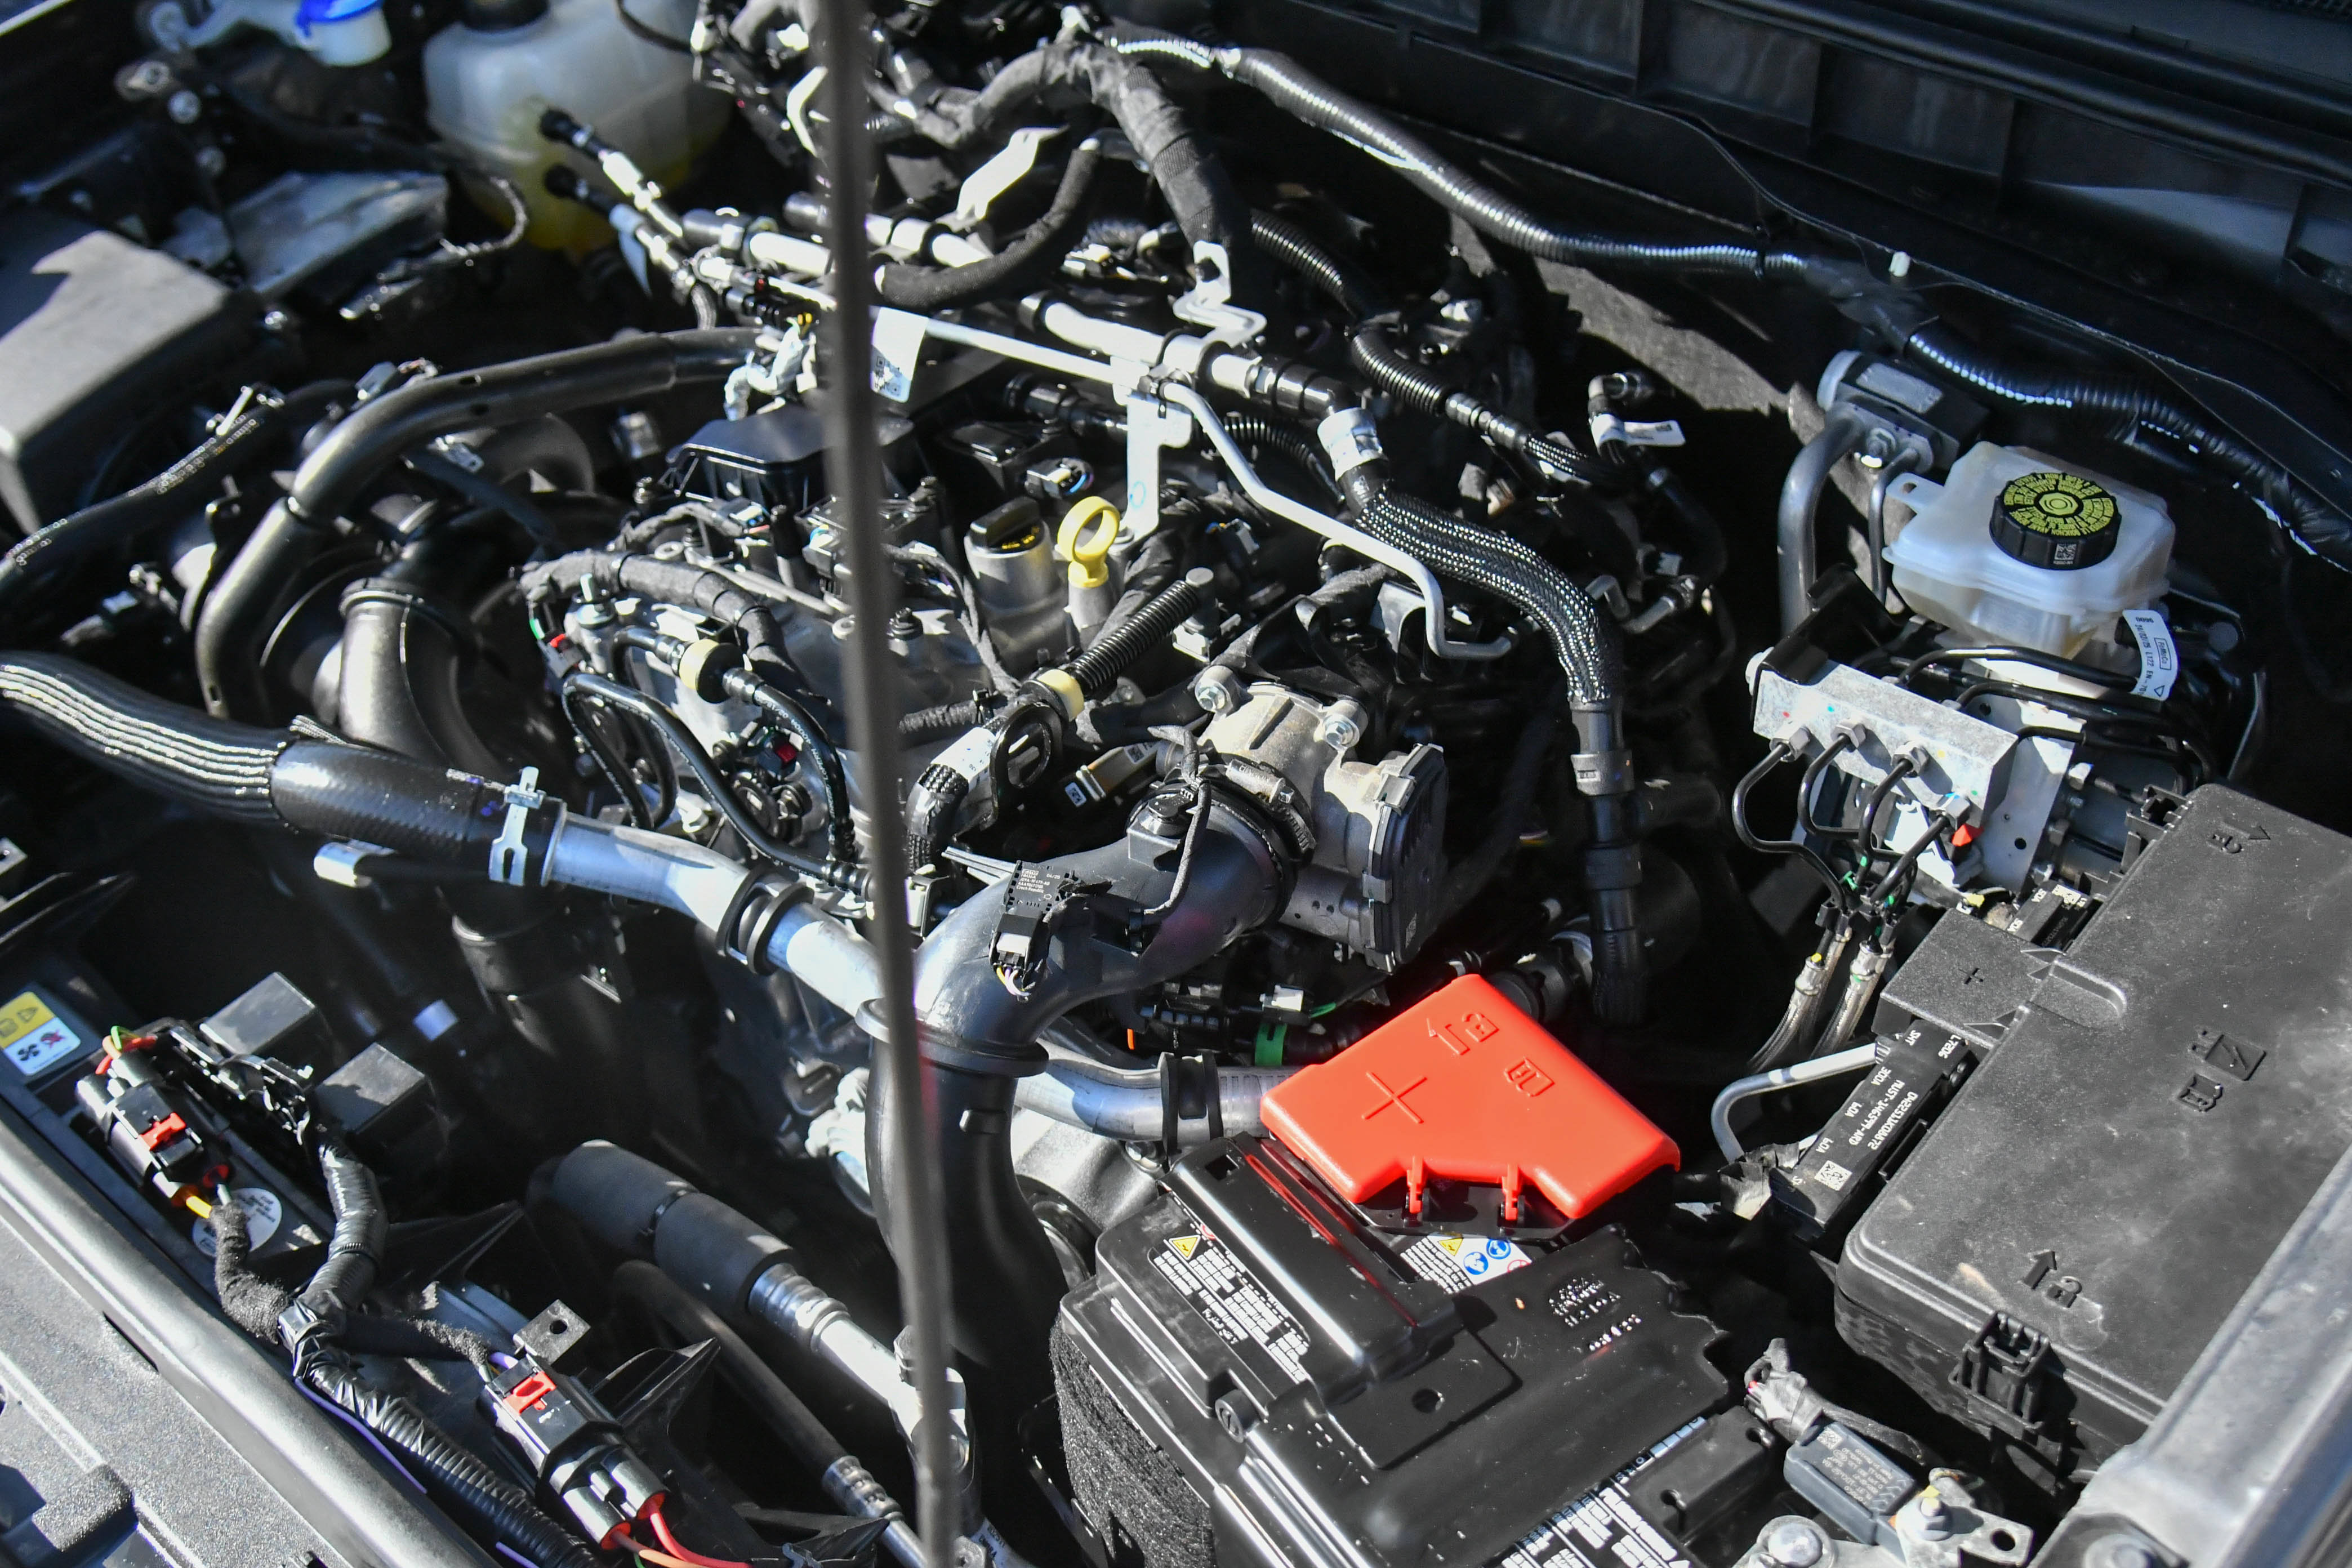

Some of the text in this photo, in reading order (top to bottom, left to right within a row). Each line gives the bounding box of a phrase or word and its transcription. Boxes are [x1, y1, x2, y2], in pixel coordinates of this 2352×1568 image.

[2158, 642, 2168, 665] FoMoCo
[2007, 888, 2047, 932] 50A 50A
[1905, 1030, 1922, 1046] SHT
[1870, 1066, 1892, 1086] 300A
